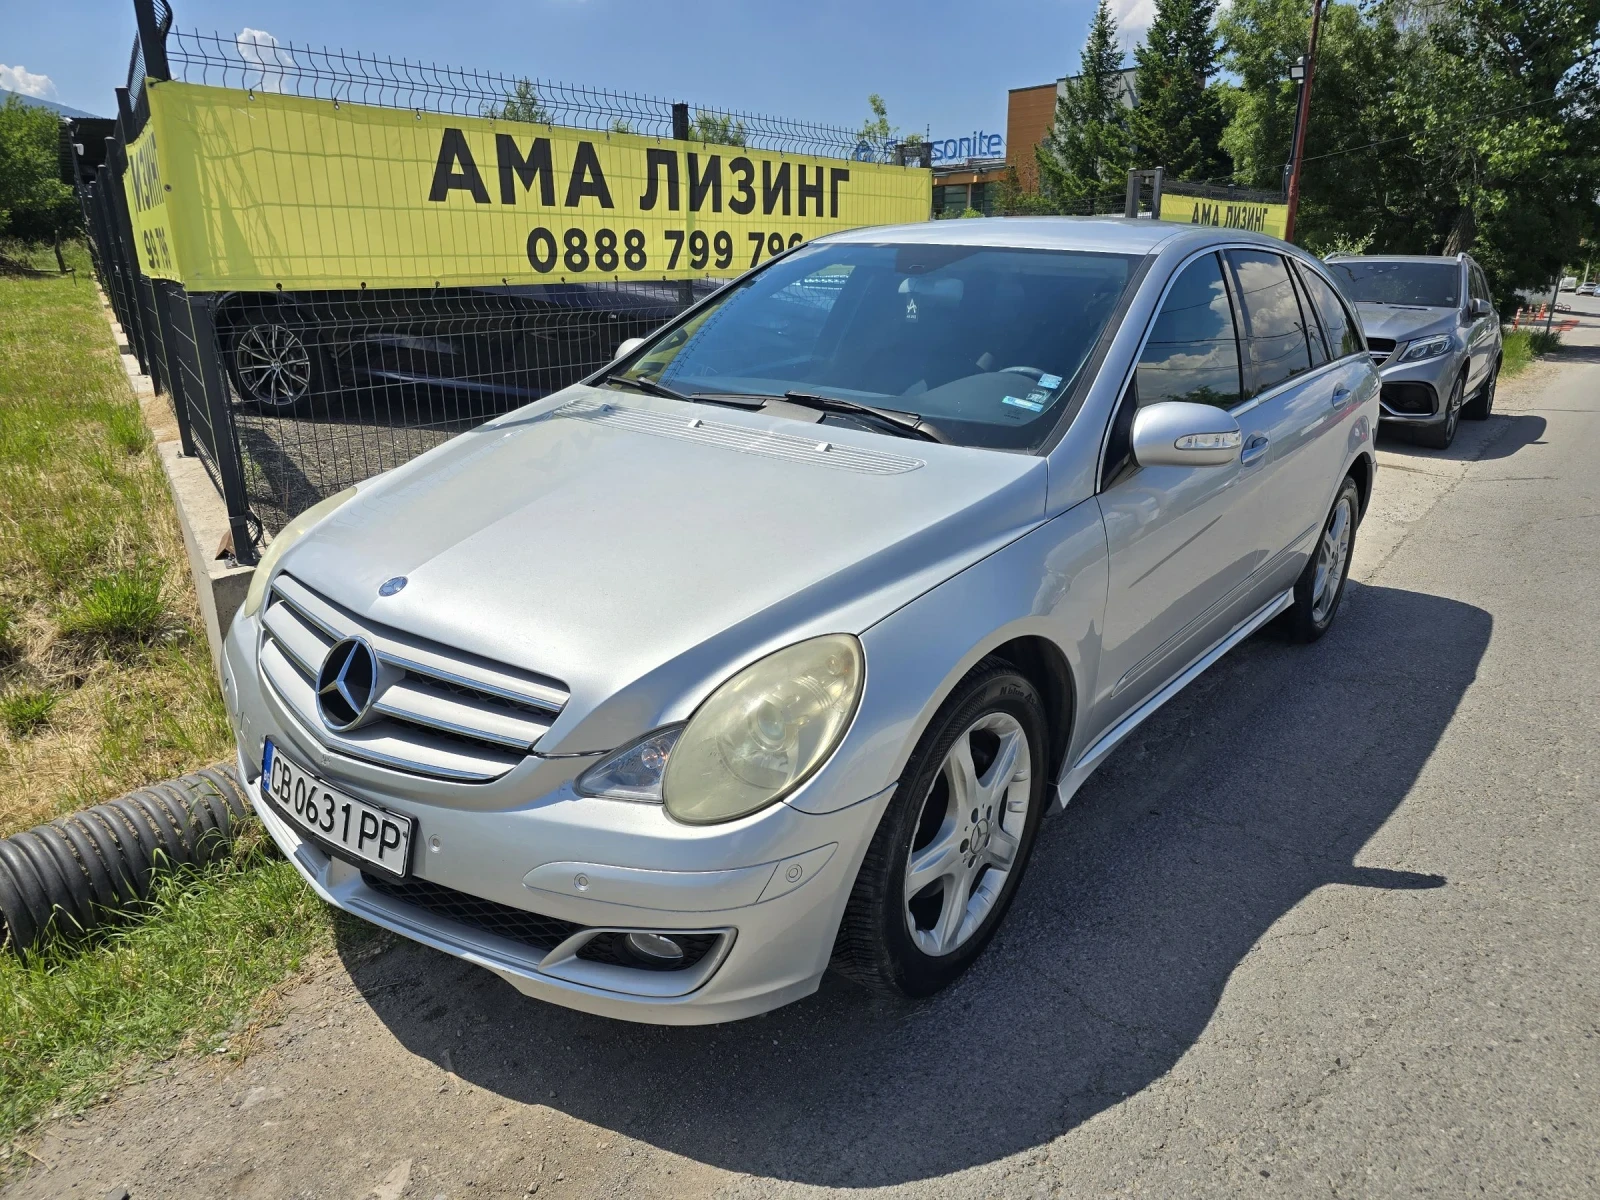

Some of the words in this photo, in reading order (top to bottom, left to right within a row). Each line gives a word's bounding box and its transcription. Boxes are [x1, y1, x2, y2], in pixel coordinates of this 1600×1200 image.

[129, 131, 165, 213] ИЗИНГ
[428, 127, 615, 209] АМА
[639, 147, 850, 219] ЛИЗИНГ
[1191, 202, 1219, 227] АМА
[1223, 205, 1268, 232] ЛИЗИНГ
[526, 227, 647, 273] 0888
[664, 229, 733, 270] 799
